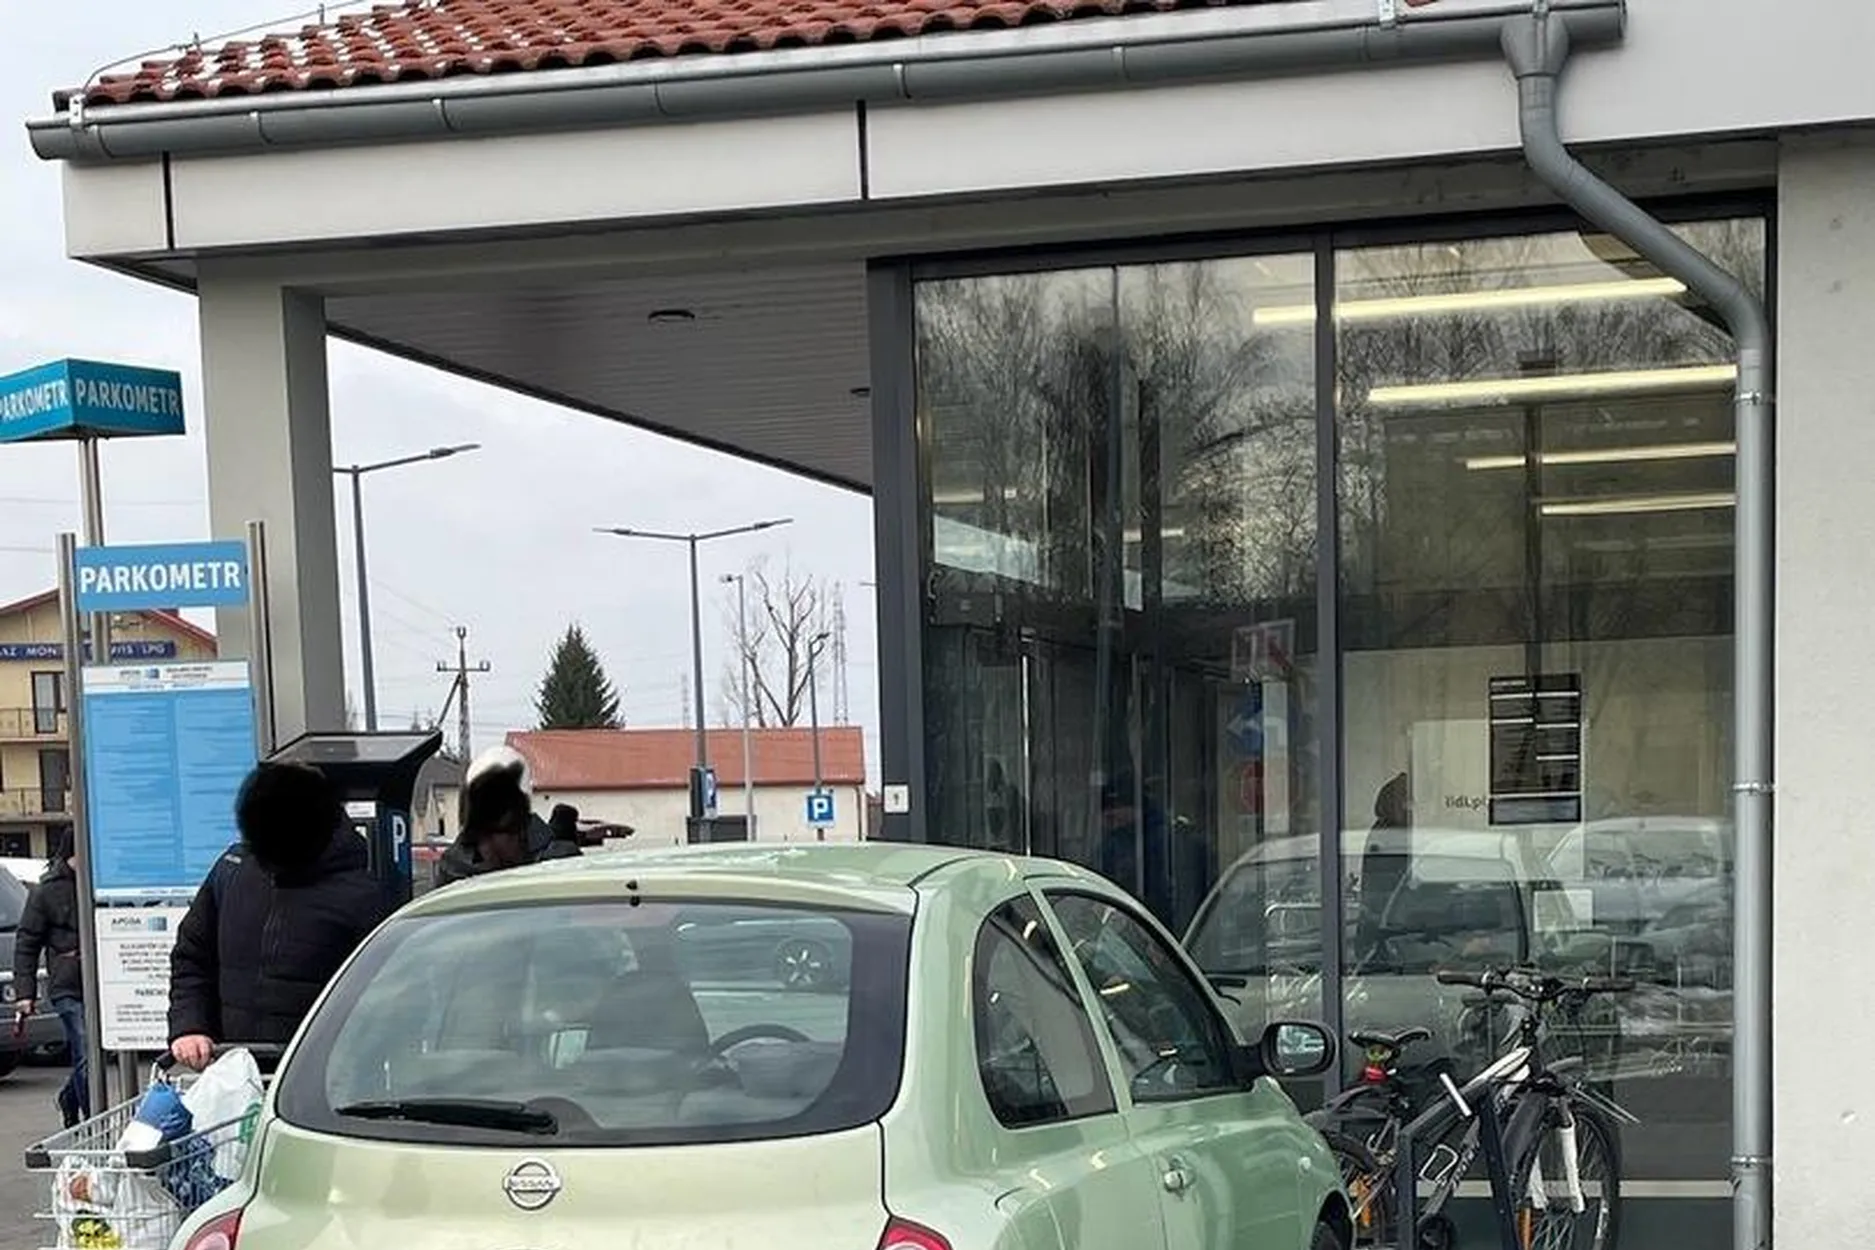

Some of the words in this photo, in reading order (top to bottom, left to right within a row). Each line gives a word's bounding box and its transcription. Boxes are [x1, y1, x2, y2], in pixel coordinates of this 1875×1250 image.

[75, 378, 179, 417] PARKOMETR
[80, 562, 241, 593] PARKOMETR
[813, 798, 829, 820] P
[392, 815, 406, 863] P
